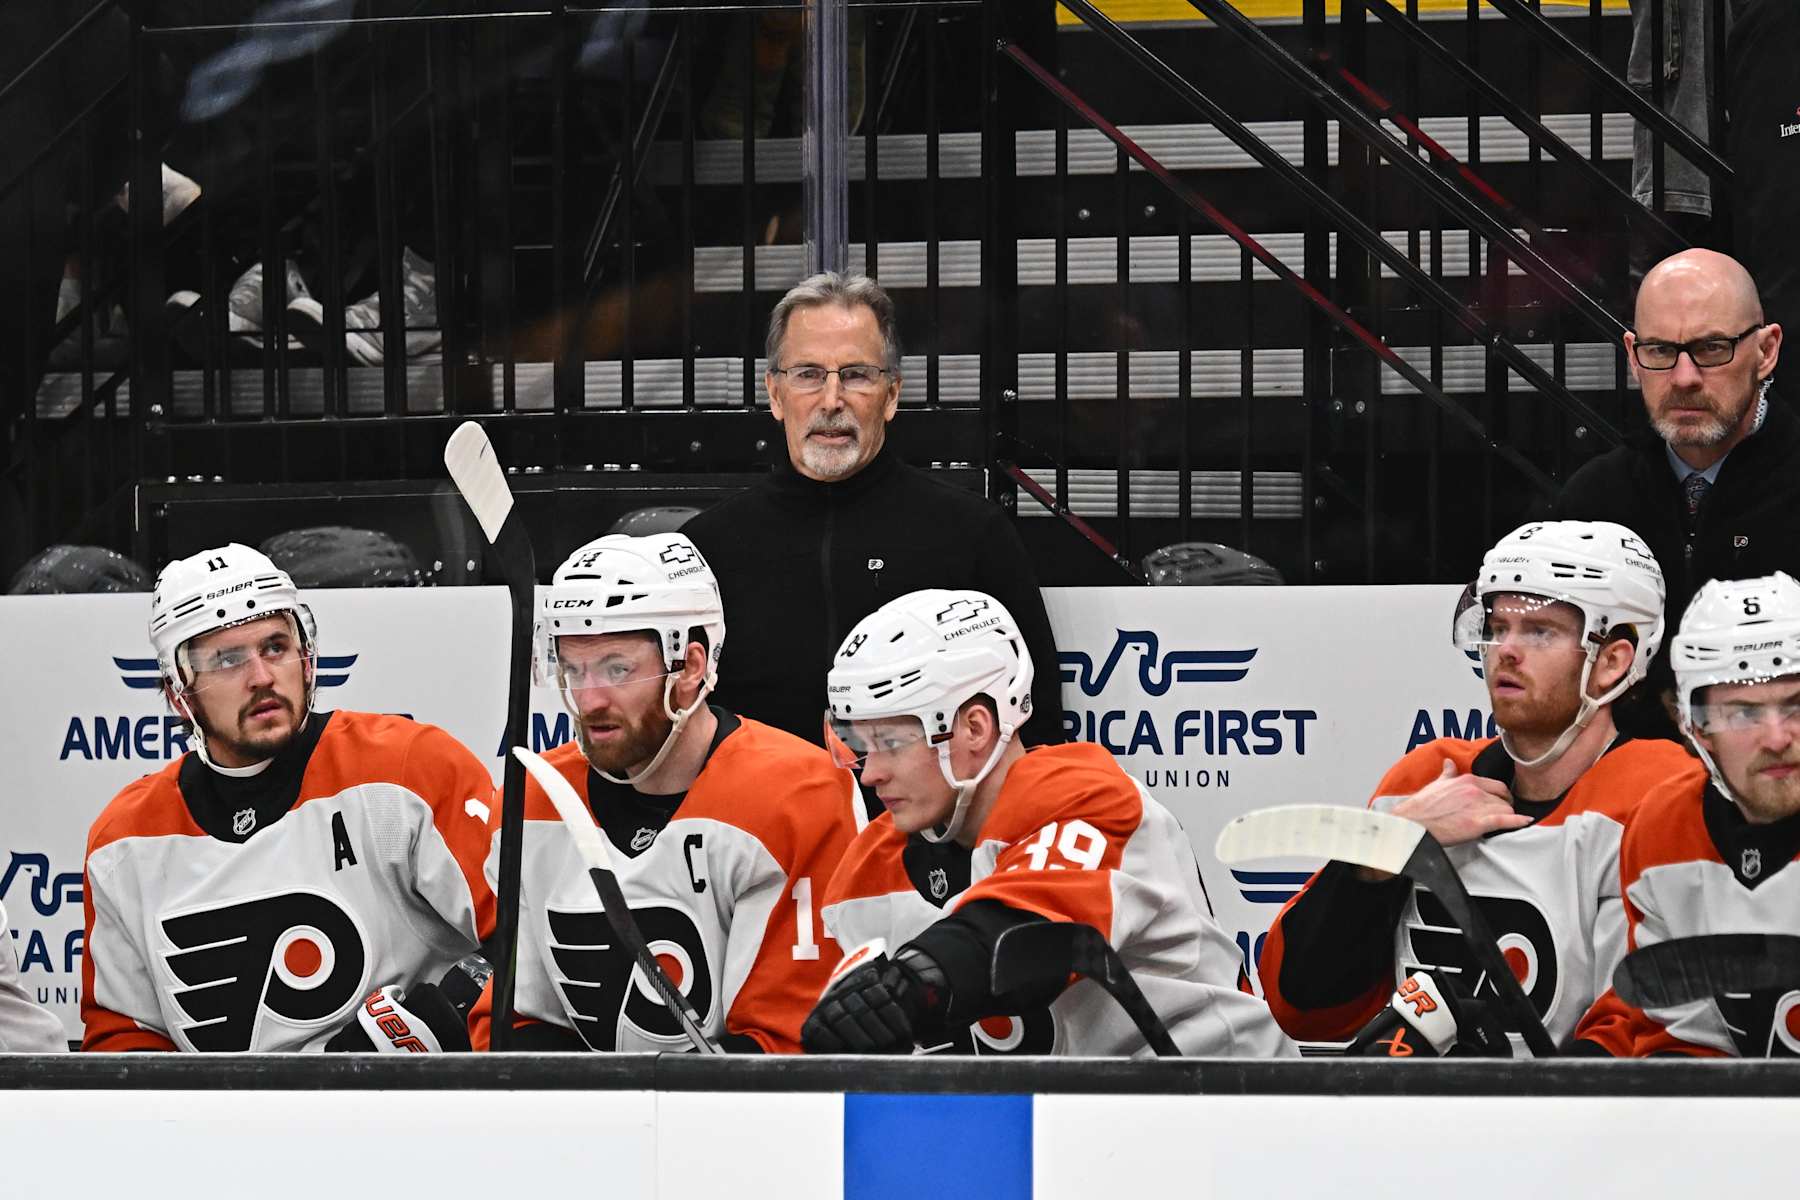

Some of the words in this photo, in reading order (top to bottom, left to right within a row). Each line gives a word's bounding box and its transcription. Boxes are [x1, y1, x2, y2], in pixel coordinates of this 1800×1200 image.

[206, 556, 229, 572] 11
[206, 580, 253, 600] BAUER
[553, 600, 594, 609] CCM
[1743, 597, 1760, 616] 6
[944, 617, 1001, 641] CHEVROLET
[1174, 710, 1318, 756] FIRST
[1146, 770, 1230, 788] UNION
[331, 810, 358, 871] A
[683, 833, 707, 894] C
